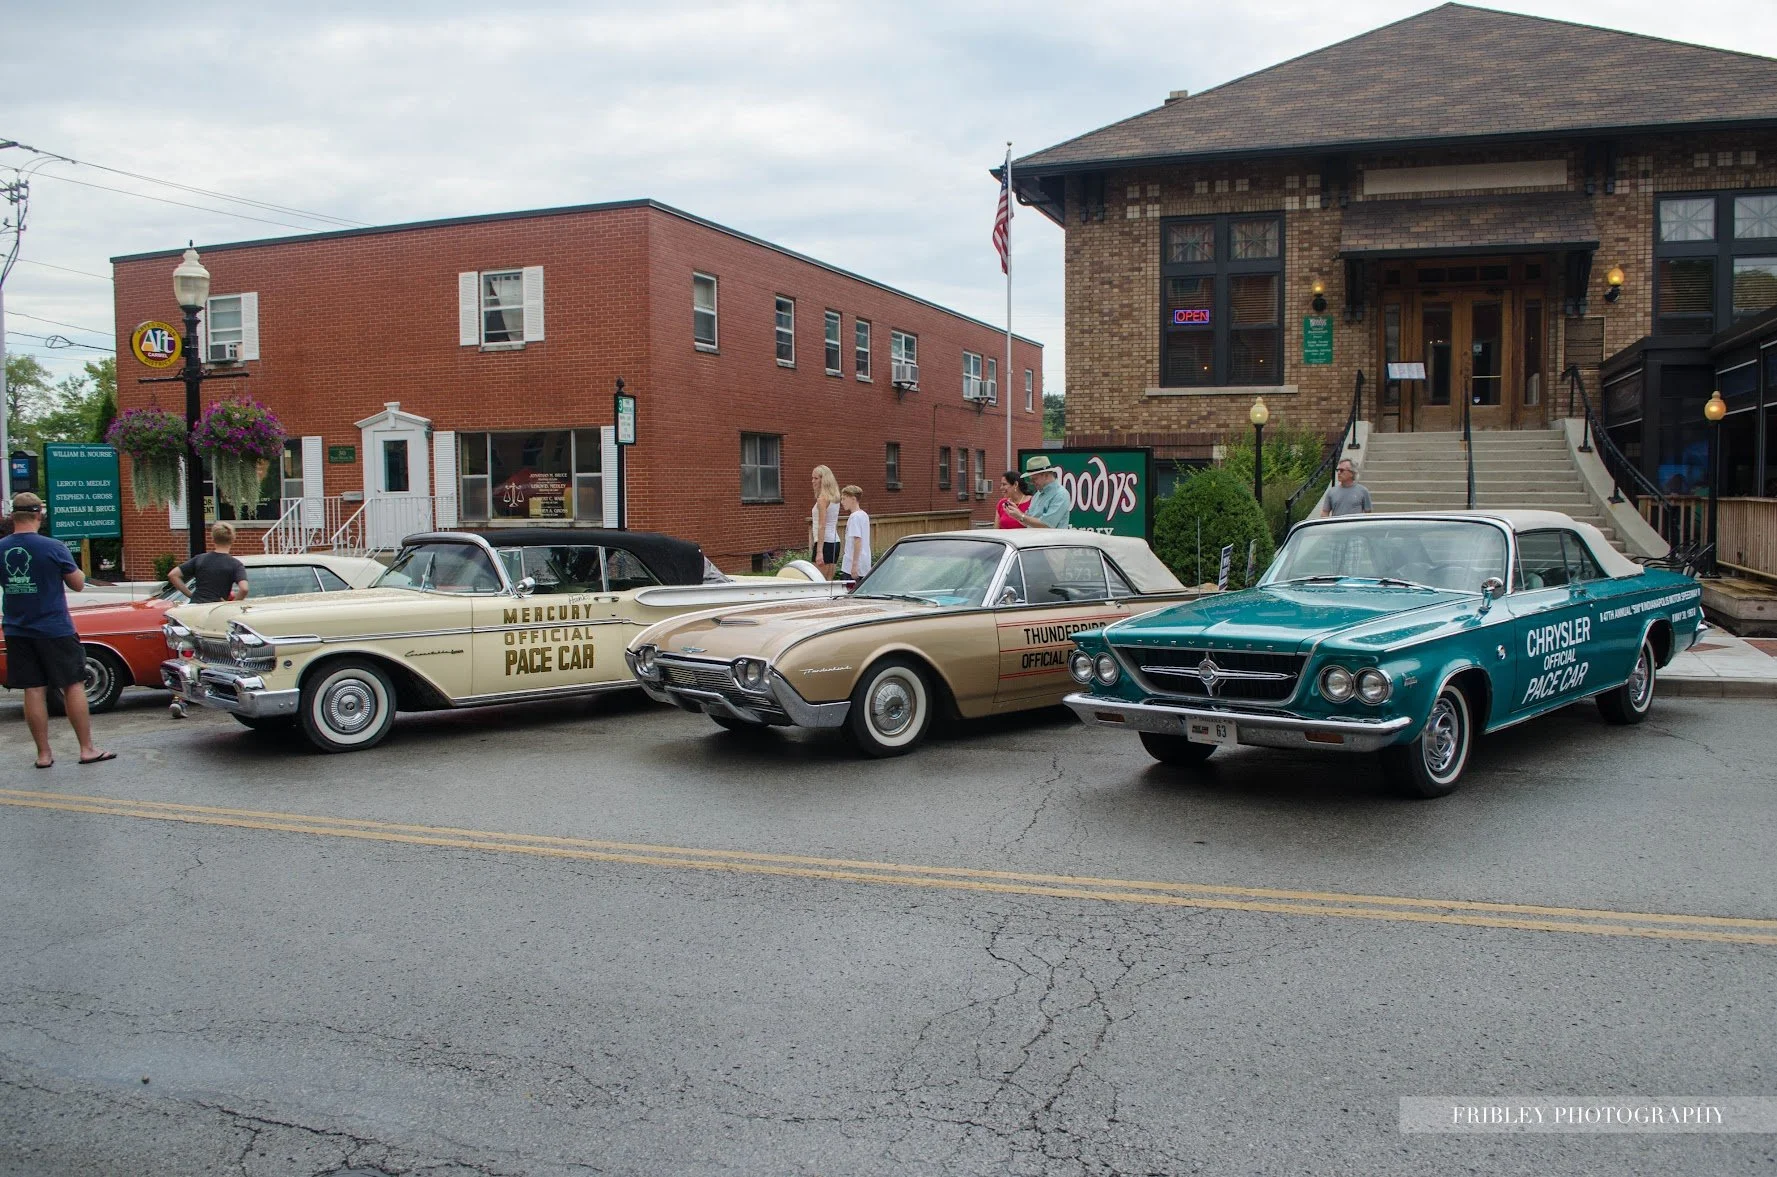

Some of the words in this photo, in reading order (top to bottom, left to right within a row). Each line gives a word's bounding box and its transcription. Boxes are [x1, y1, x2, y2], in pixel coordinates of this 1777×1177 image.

[1176, 311, 1208, 322] OPEN
[141, 329, 175, 354] Art
[1057, 455, 1138, 521] oodys
[54, 506, 86, 514] JONATHAN
[503, 604, 592, 624] MERCURY
[504, 627, 593, 646] OFFICIAL
[1526, 616, 1591, 657] CHRYSLER
[505, 646, 552, 676] PACE
[558, 644, 594, 671] CAR
[1022, 650, 1064, 669] OFFICIAL
[1543, 648, 1577, 671] OFFICIAL
[1521, 669, 1562, 705] PACE
[1559, 661, 1589, 692] CAR
[1216, 724, 1227, 738] 63
